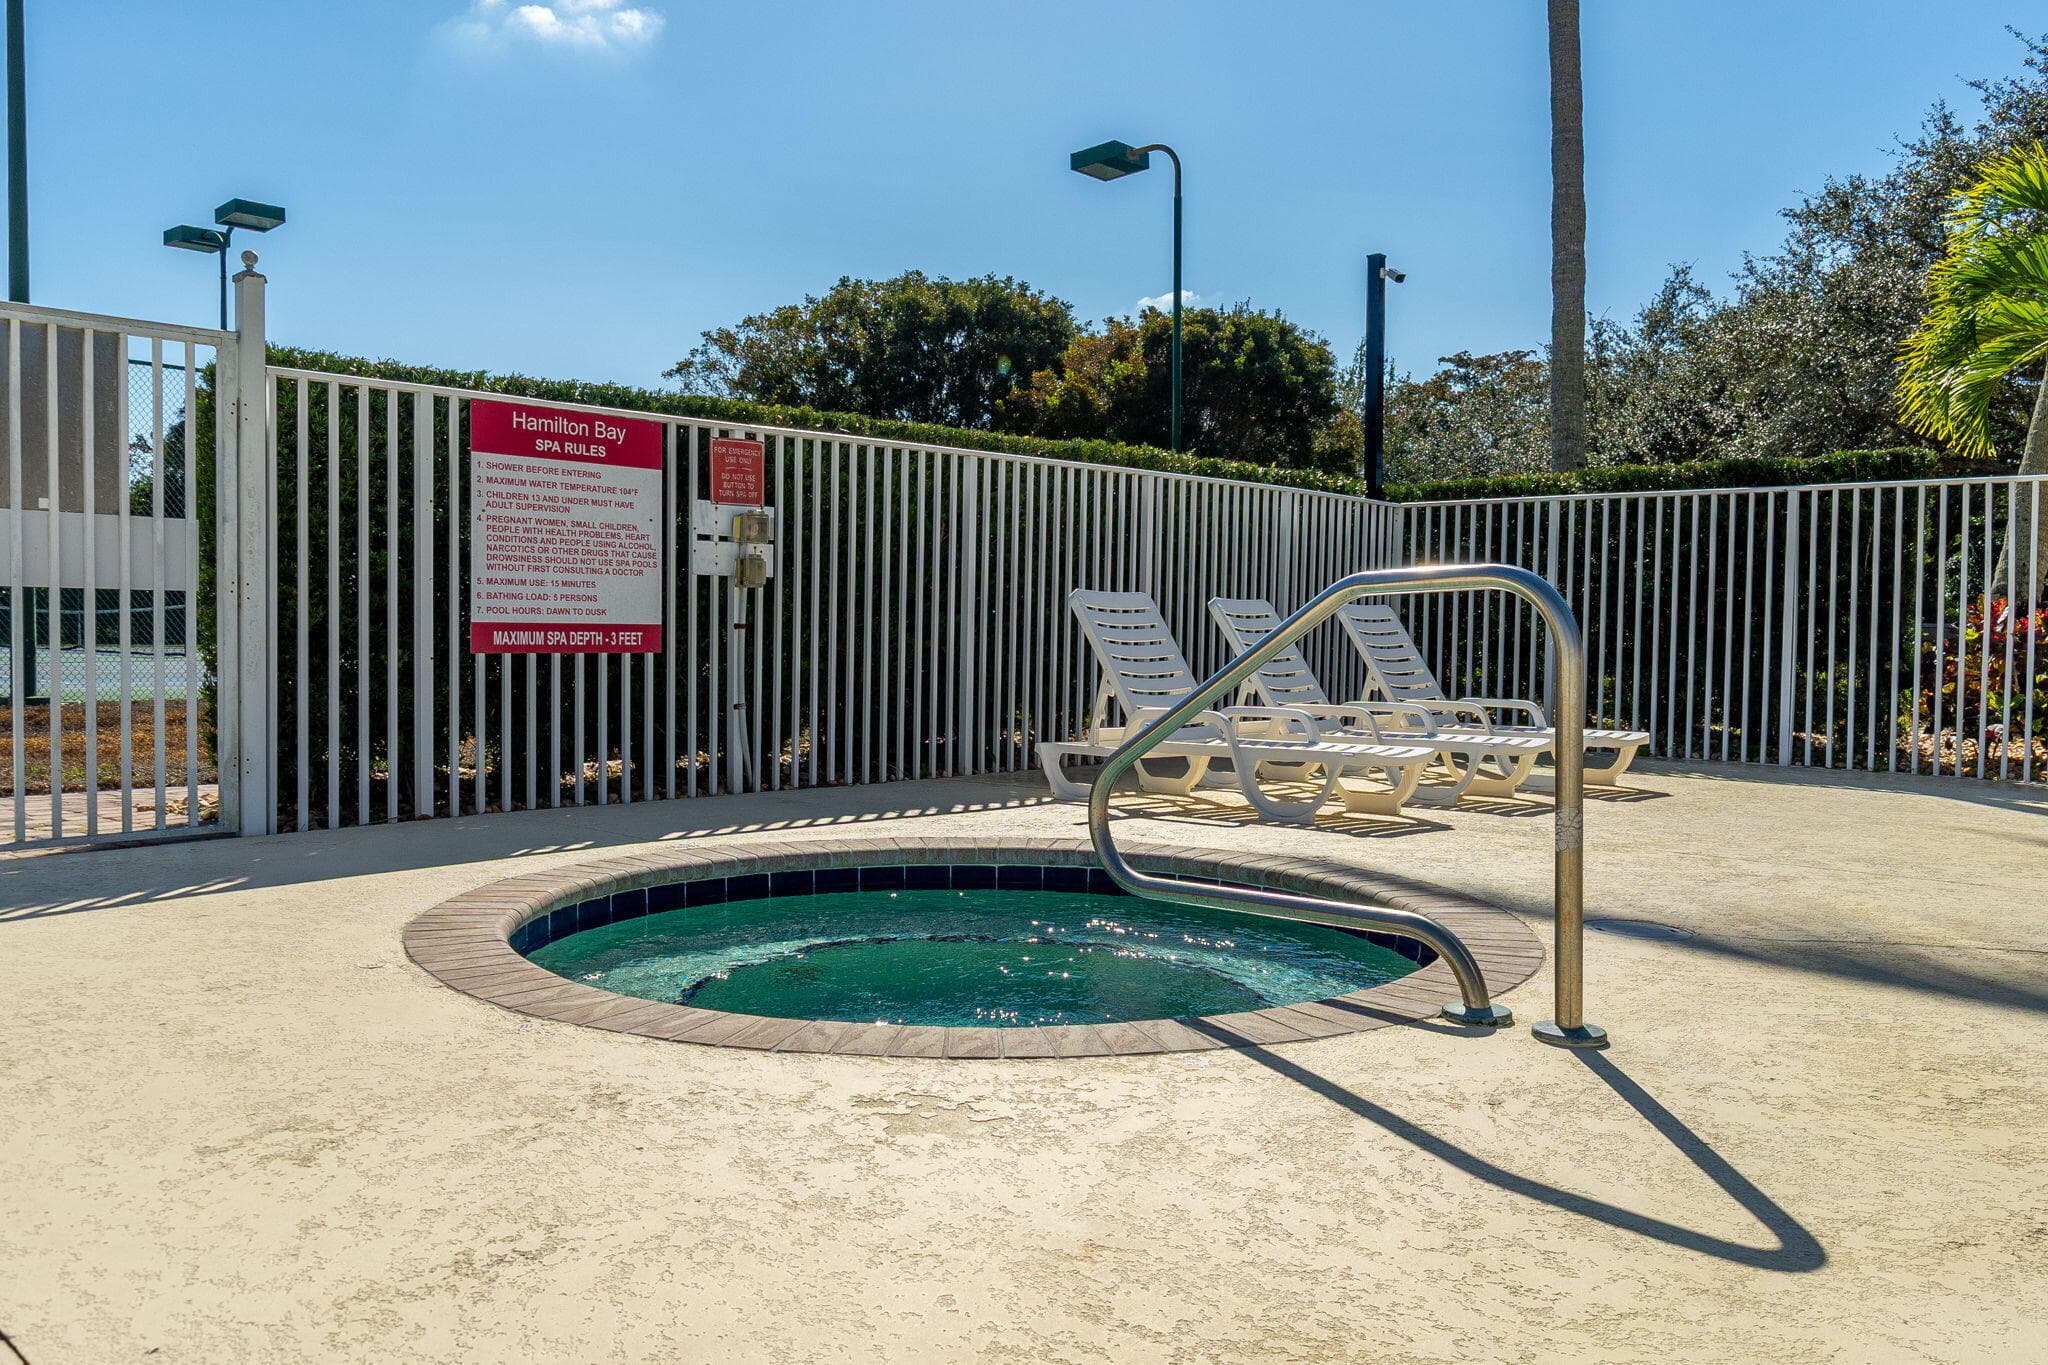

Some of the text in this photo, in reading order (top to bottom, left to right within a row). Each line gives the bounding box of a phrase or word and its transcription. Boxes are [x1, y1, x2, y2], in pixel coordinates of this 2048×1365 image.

[512, 411, 626, 445] Hamilton Bay
[536, 438, 606, 457] SPA RULES
[486, 462, 524, 472] SHOWER
[526, 466, 560, 475] BEFORE
[562, 468, 601, 479] ENTERING
[477, 476, 484, 484] 2.
[486, 476, 526, 486] MAXIMUM
[529, 480, 558, 490] WATER
[560, 482, 617, 494] TEMPERATURE
[486, 490, 528, 500] CHILDREN
[542, 495, 560, 504] AND
[562, 497, 590, 506] UNDER
[591, 499, 612, 508] MUST
[614, 501, 634, 510] HAVE
[486, 500, 570, 513] ADULT SUPERVISION
[486, 514, 532, 525] PREGNANT
[570, 520, 596, 529] SMALL
[486, 524, 650, 541] PEOPLE WITH HEALTH PROBLEMS, HEART
[486, 534, 538, 544] CONDITIONS
[540, 538, 557, 546] AND
[560, 538, 590, 547] PEOPLE
[592, 540, 616, 548] USING
[486, 544, 656, 560] NARCOTICS OR OTHER DRUGS THAT CAUSE
[486, 554, 542, 564] DROWSINESS
[544, 556, 578, 564] SHOULD
[598, 558, 614, 566] USE
[616, 560, 630, 568] SPA
[632, 560, 658, 568] POOLS
[486, 563, 526, 572] WITHOUT
[528, 564, 550, 572] FIRST
[552, 566, 603, 575] CONSULTING
[612, 568, 644, 576] DOCTOR
[486, 578, 526, 586] MAXIMUM
[562, 580, 596, 588] MINUTES
[486, 592, 524, 600] BATHING
[560, 594, 598, 602] PERSONS
[493, 630, 544, 645] MAXIMUM
[546, 631, 568, 645] SPA
[570, 632, 603, 646] DEPTH
[610, 632, 616, 646] 3
[618, 632, 643, 646] FEET
